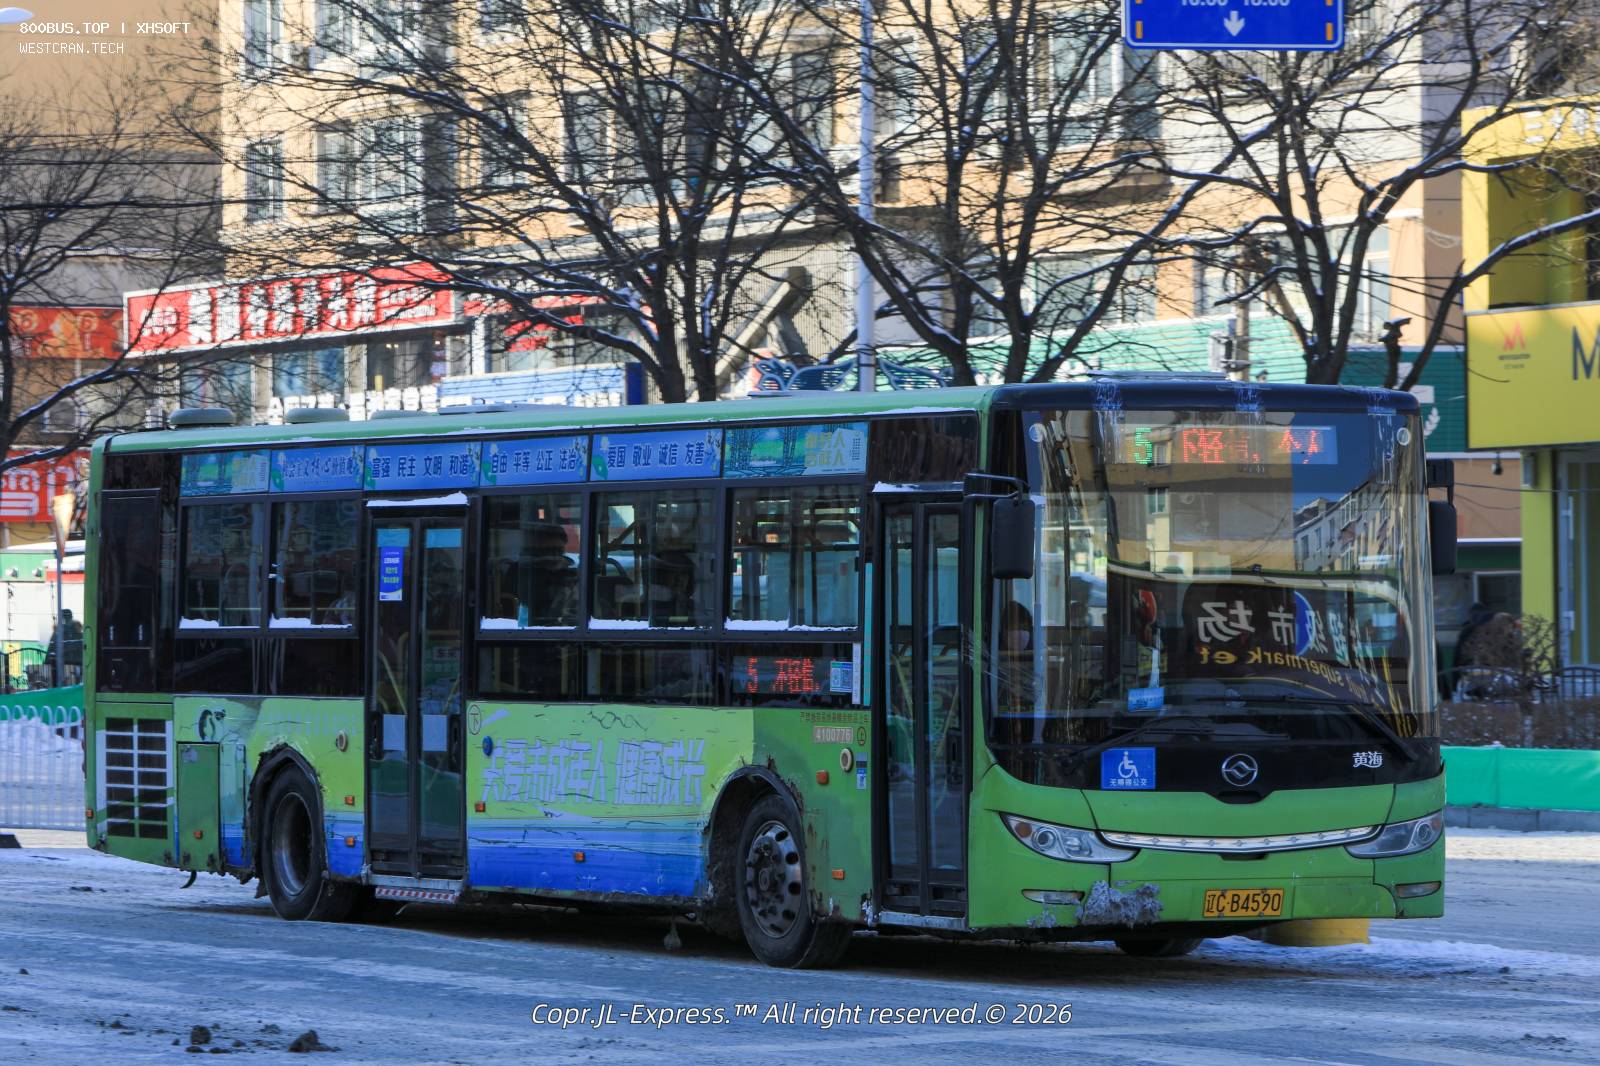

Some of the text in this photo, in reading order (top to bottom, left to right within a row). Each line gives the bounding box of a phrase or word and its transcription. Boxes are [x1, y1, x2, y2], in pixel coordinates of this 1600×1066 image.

[607, 441, 704, 468] 爱国 敬业 诚信 友善
[1134, 427, 1152, 464] 5
[372, 453, 469, 478] 富强 民主 文明 和谐
[491, 447, 577, 474] 自由 平等 公正 法治
[747, 657, 758, 693] 5
[482, 739, 706, 807] 关爱未成年人 健康成长
[1352, 751, 1383, 769] 黄海
[1109, 777, 1149, 787] 无障碍公交
